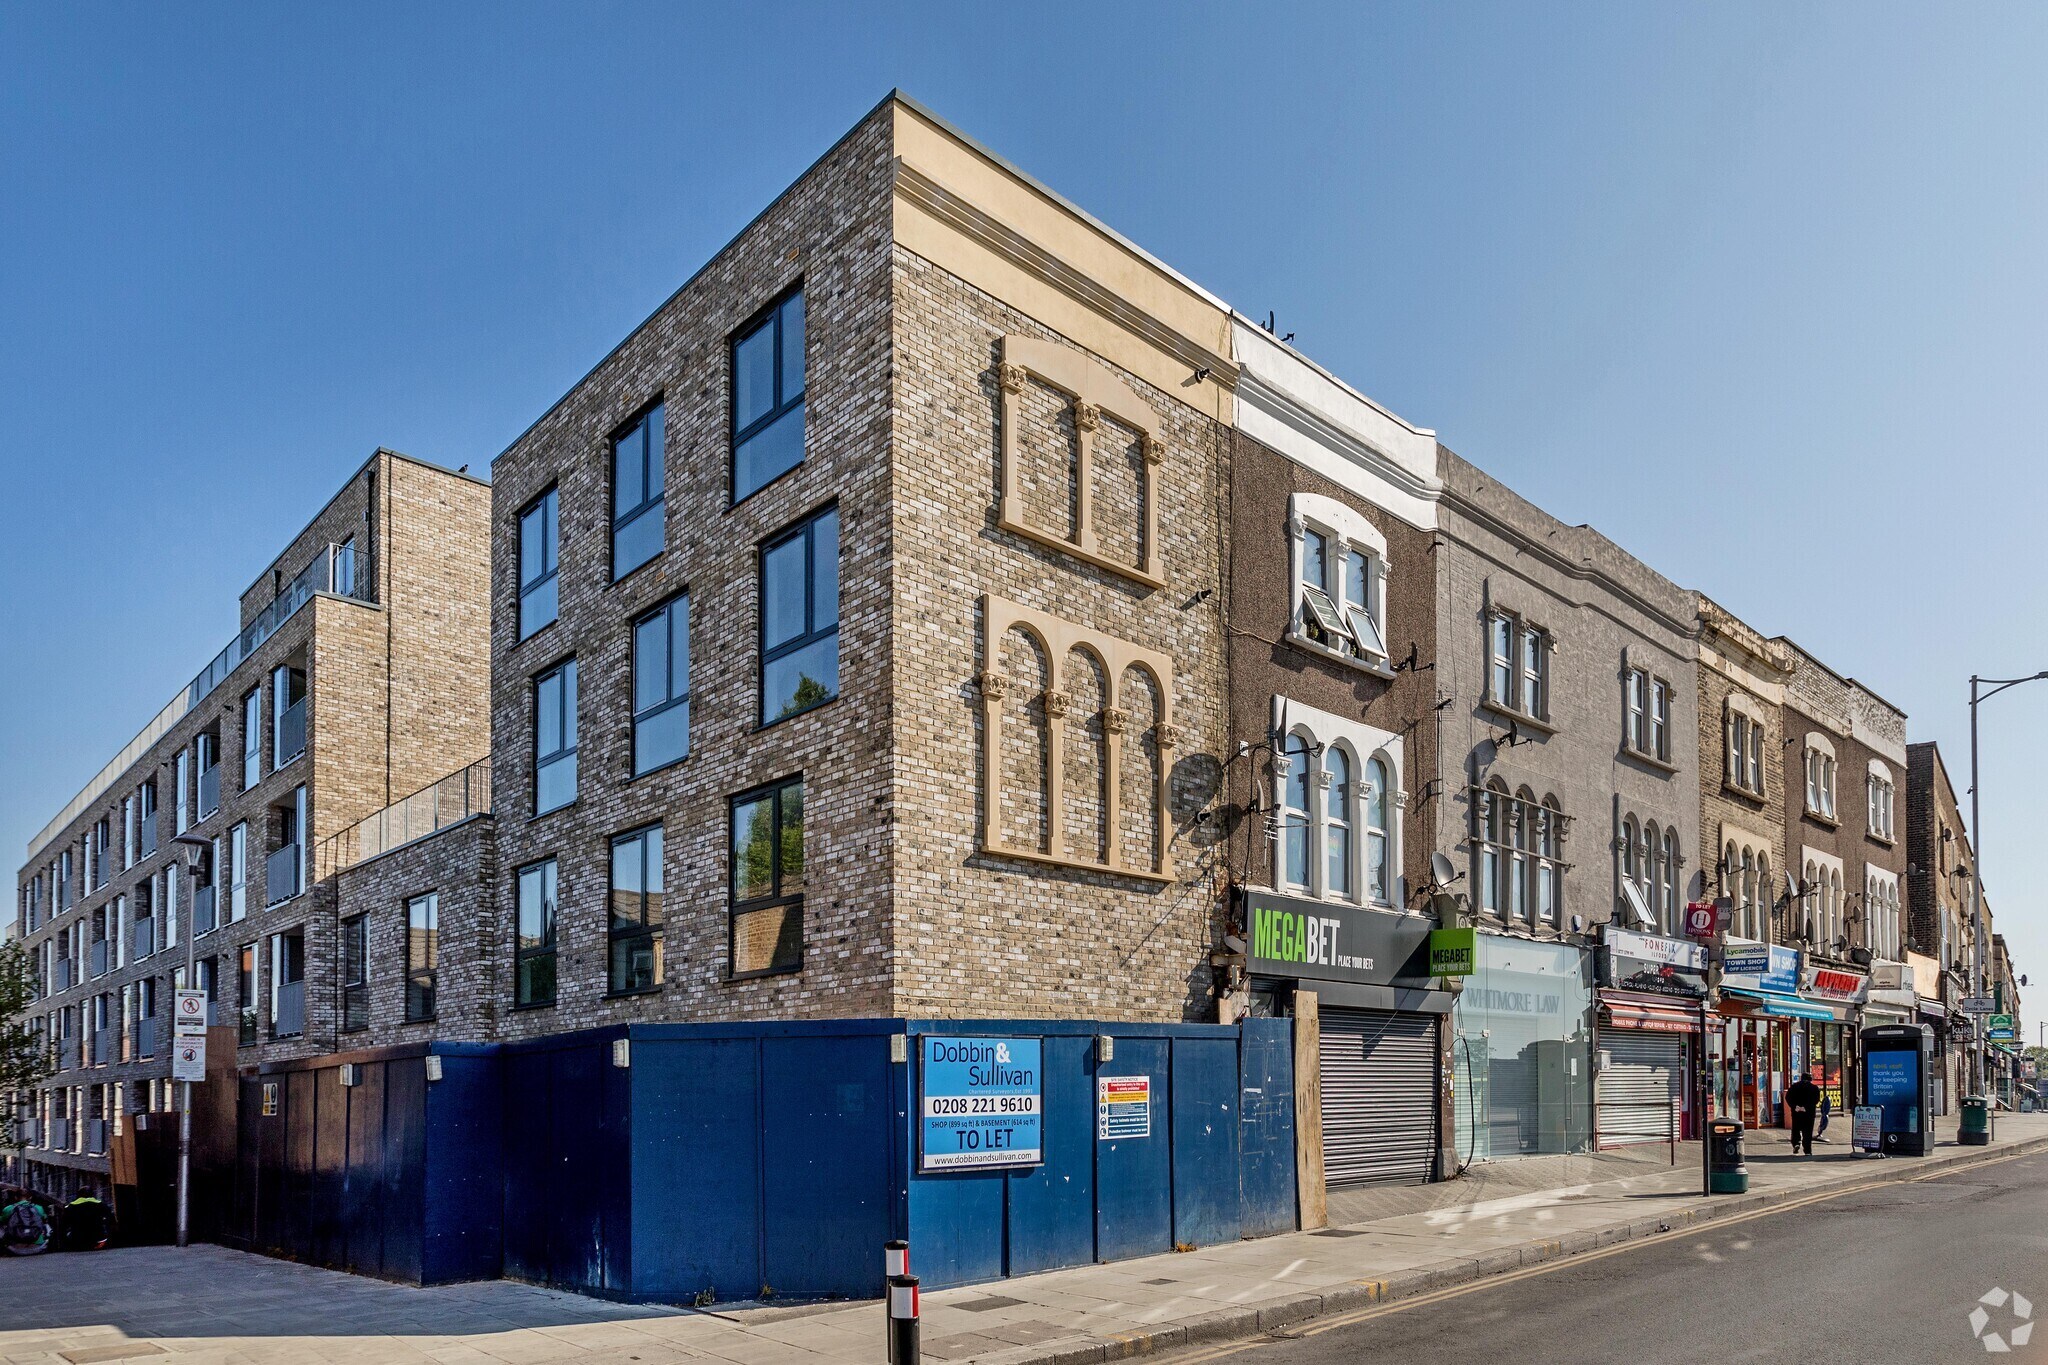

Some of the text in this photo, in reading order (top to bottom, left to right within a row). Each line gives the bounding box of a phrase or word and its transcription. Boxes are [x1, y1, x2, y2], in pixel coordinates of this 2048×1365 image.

[1254, 908, 1340, 966] MEGABET
[1645, 939, 1676, 953] FONEFIX
[1726, 947, 1766, 956] Lycamobile
[1338, 955, 1373, 970] PLACE YOUR BETS
[1433, 948, 1470, 963] MEGABET
[1782, 955, 1796, 971] SHOP
[1433, 964, 1445, 972] PLACE
[1446, 963, 1458, 971] YOUR
[1466, 988, 1560, 1014] WHITMORE LAW
[933, 1042, 1011, 1063] Dobbin &
[969, 1066, 1032, 1086] Sullivan
[932, 1097, 1032, 1114] 0208 221 9610
[948, 1120, 960, 1129] (899
[956, 1129, 1013, 1149] TO LET
[934, 1152, 1032, 1165] www.dobbinandsullivan.com
